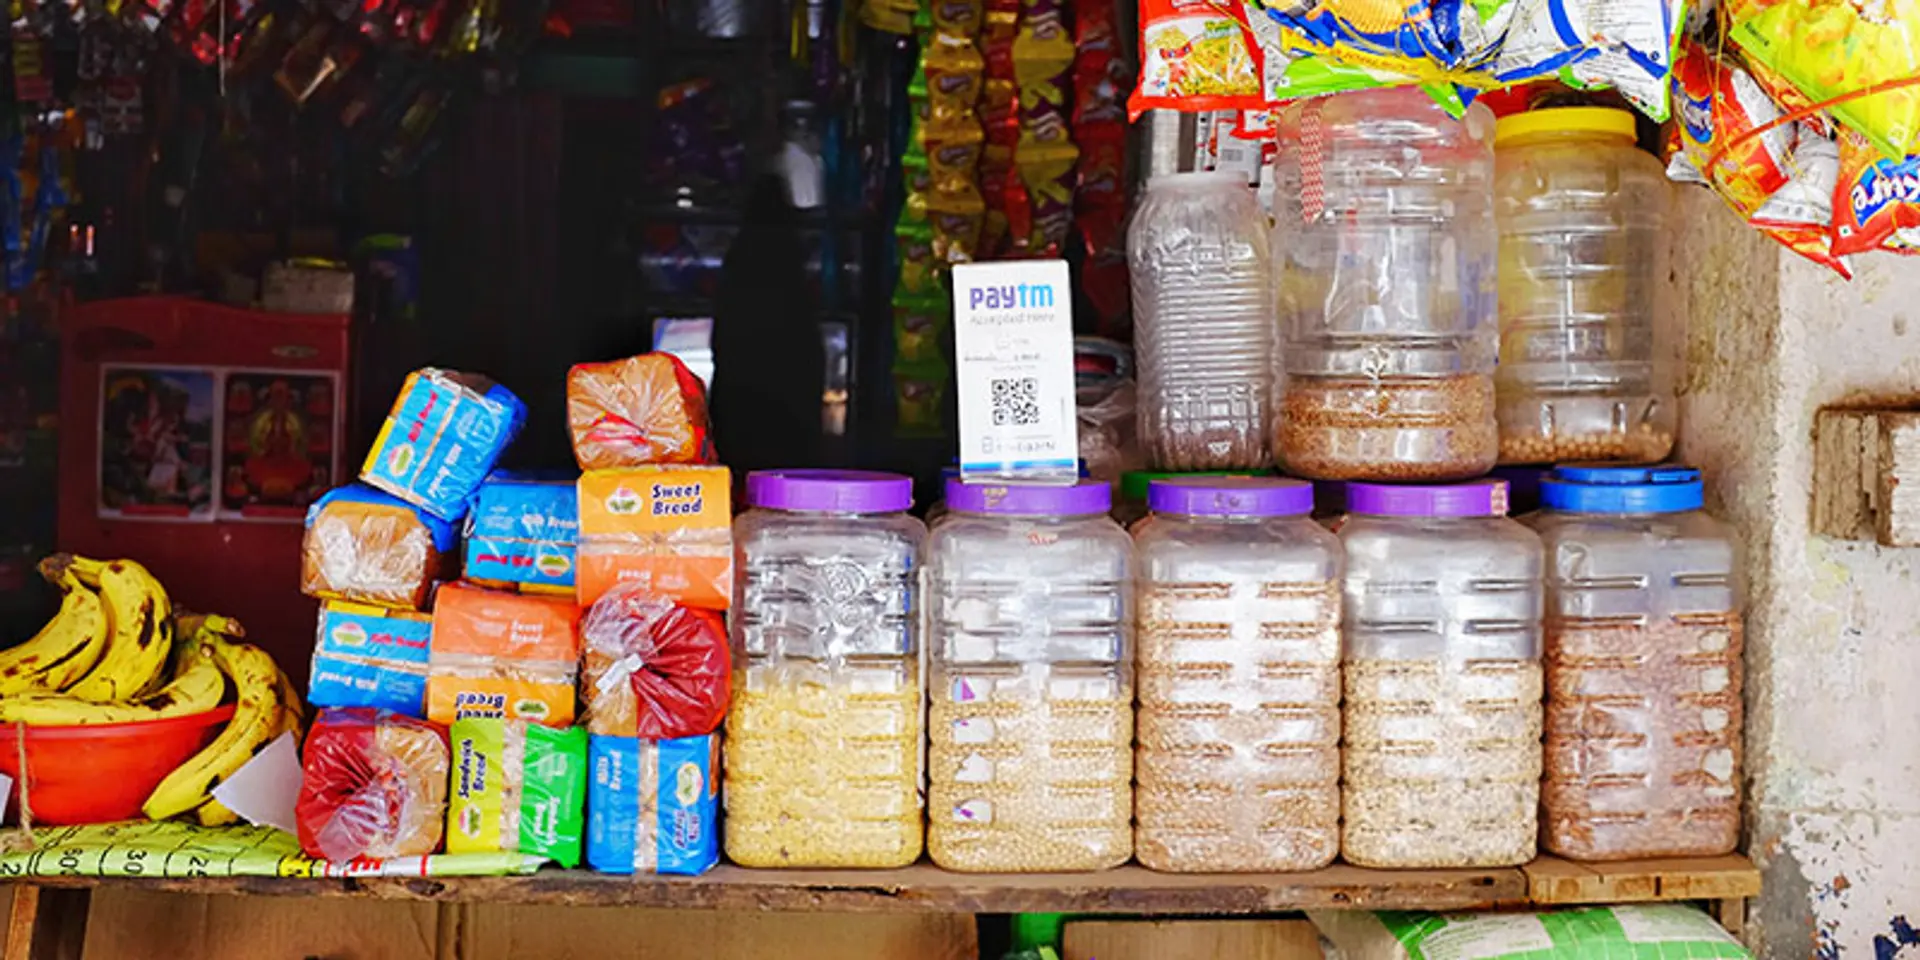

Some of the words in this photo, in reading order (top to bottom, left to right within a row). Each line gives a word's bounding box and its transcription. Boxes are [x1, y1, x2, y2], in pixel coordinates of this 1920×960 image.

[652, 483, 702, 499] Sweet
[652, 498, 703, 515] Bread
[455, 693, 505, 708] Bread
[458, 739, 473, 799] Sandwich
[472, 751, 486, 792] Bread
[123, 850, 147, 875] 30
